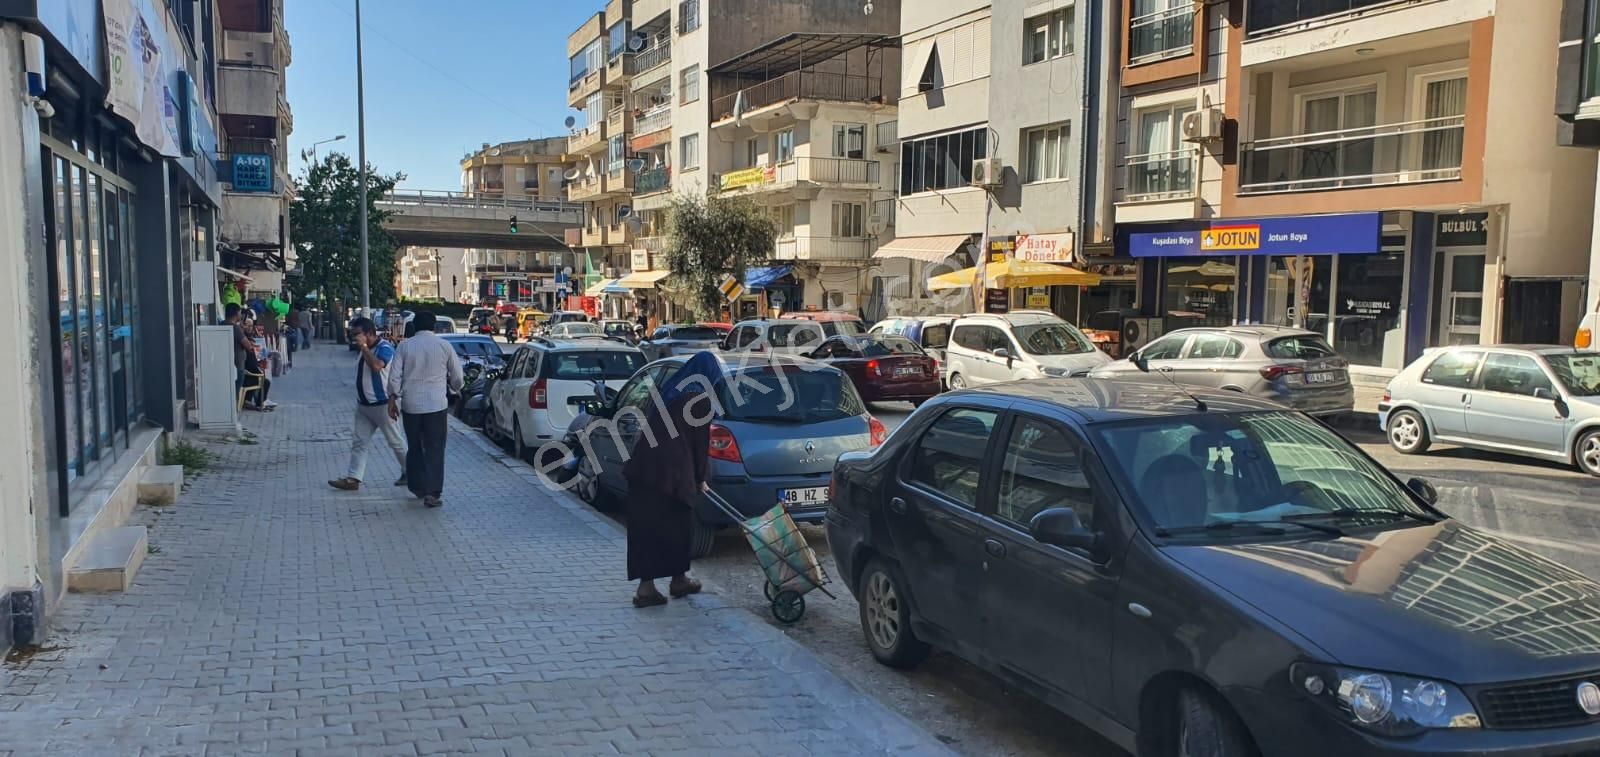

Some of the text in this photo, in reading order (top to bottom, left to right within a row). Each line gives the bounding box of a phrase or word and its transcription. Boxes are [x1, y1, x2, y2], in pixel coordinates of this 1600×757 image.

[1442, 219, 1477, 232] BÜLBÜL
[1178, 236, 1194, 245] Boya
[1216, 231, 1257, 246] JOTUN
[1268, 232, 1308, 242] Jotun Boya
[1027, 238, 1057, 252] Hatay
[1025, 250, 1057, 261] Döner
[785, 490, 797, 501] 48
[804, 489, 817, 500] HZ
